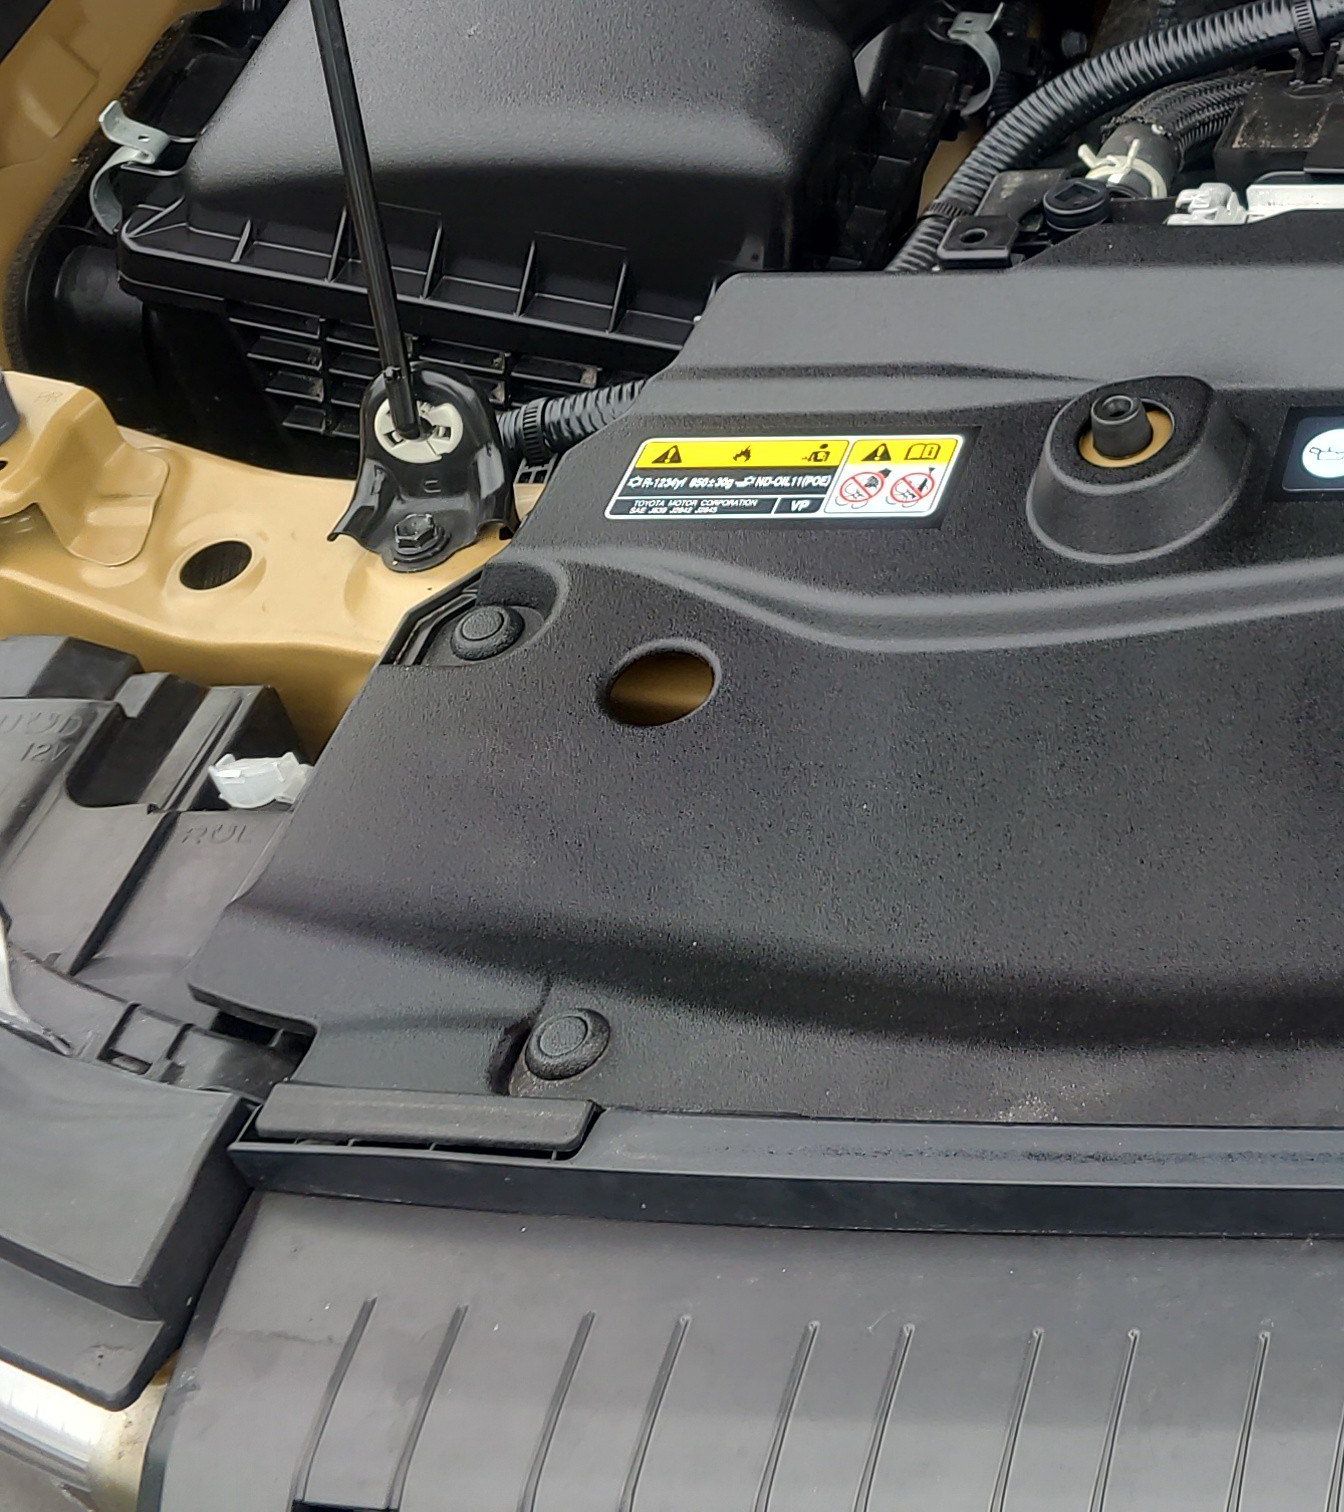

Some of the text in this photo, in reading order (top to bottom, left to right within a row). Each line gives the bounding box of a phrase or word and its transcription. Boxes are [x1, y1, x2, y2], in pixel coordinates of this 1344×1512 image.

[641, 476, 689, 490] R-1234yf
[628, 506, 646, 514] SAE
[634, 499, 811, 512] TOYOTA MOTOR CORPORATION VP
